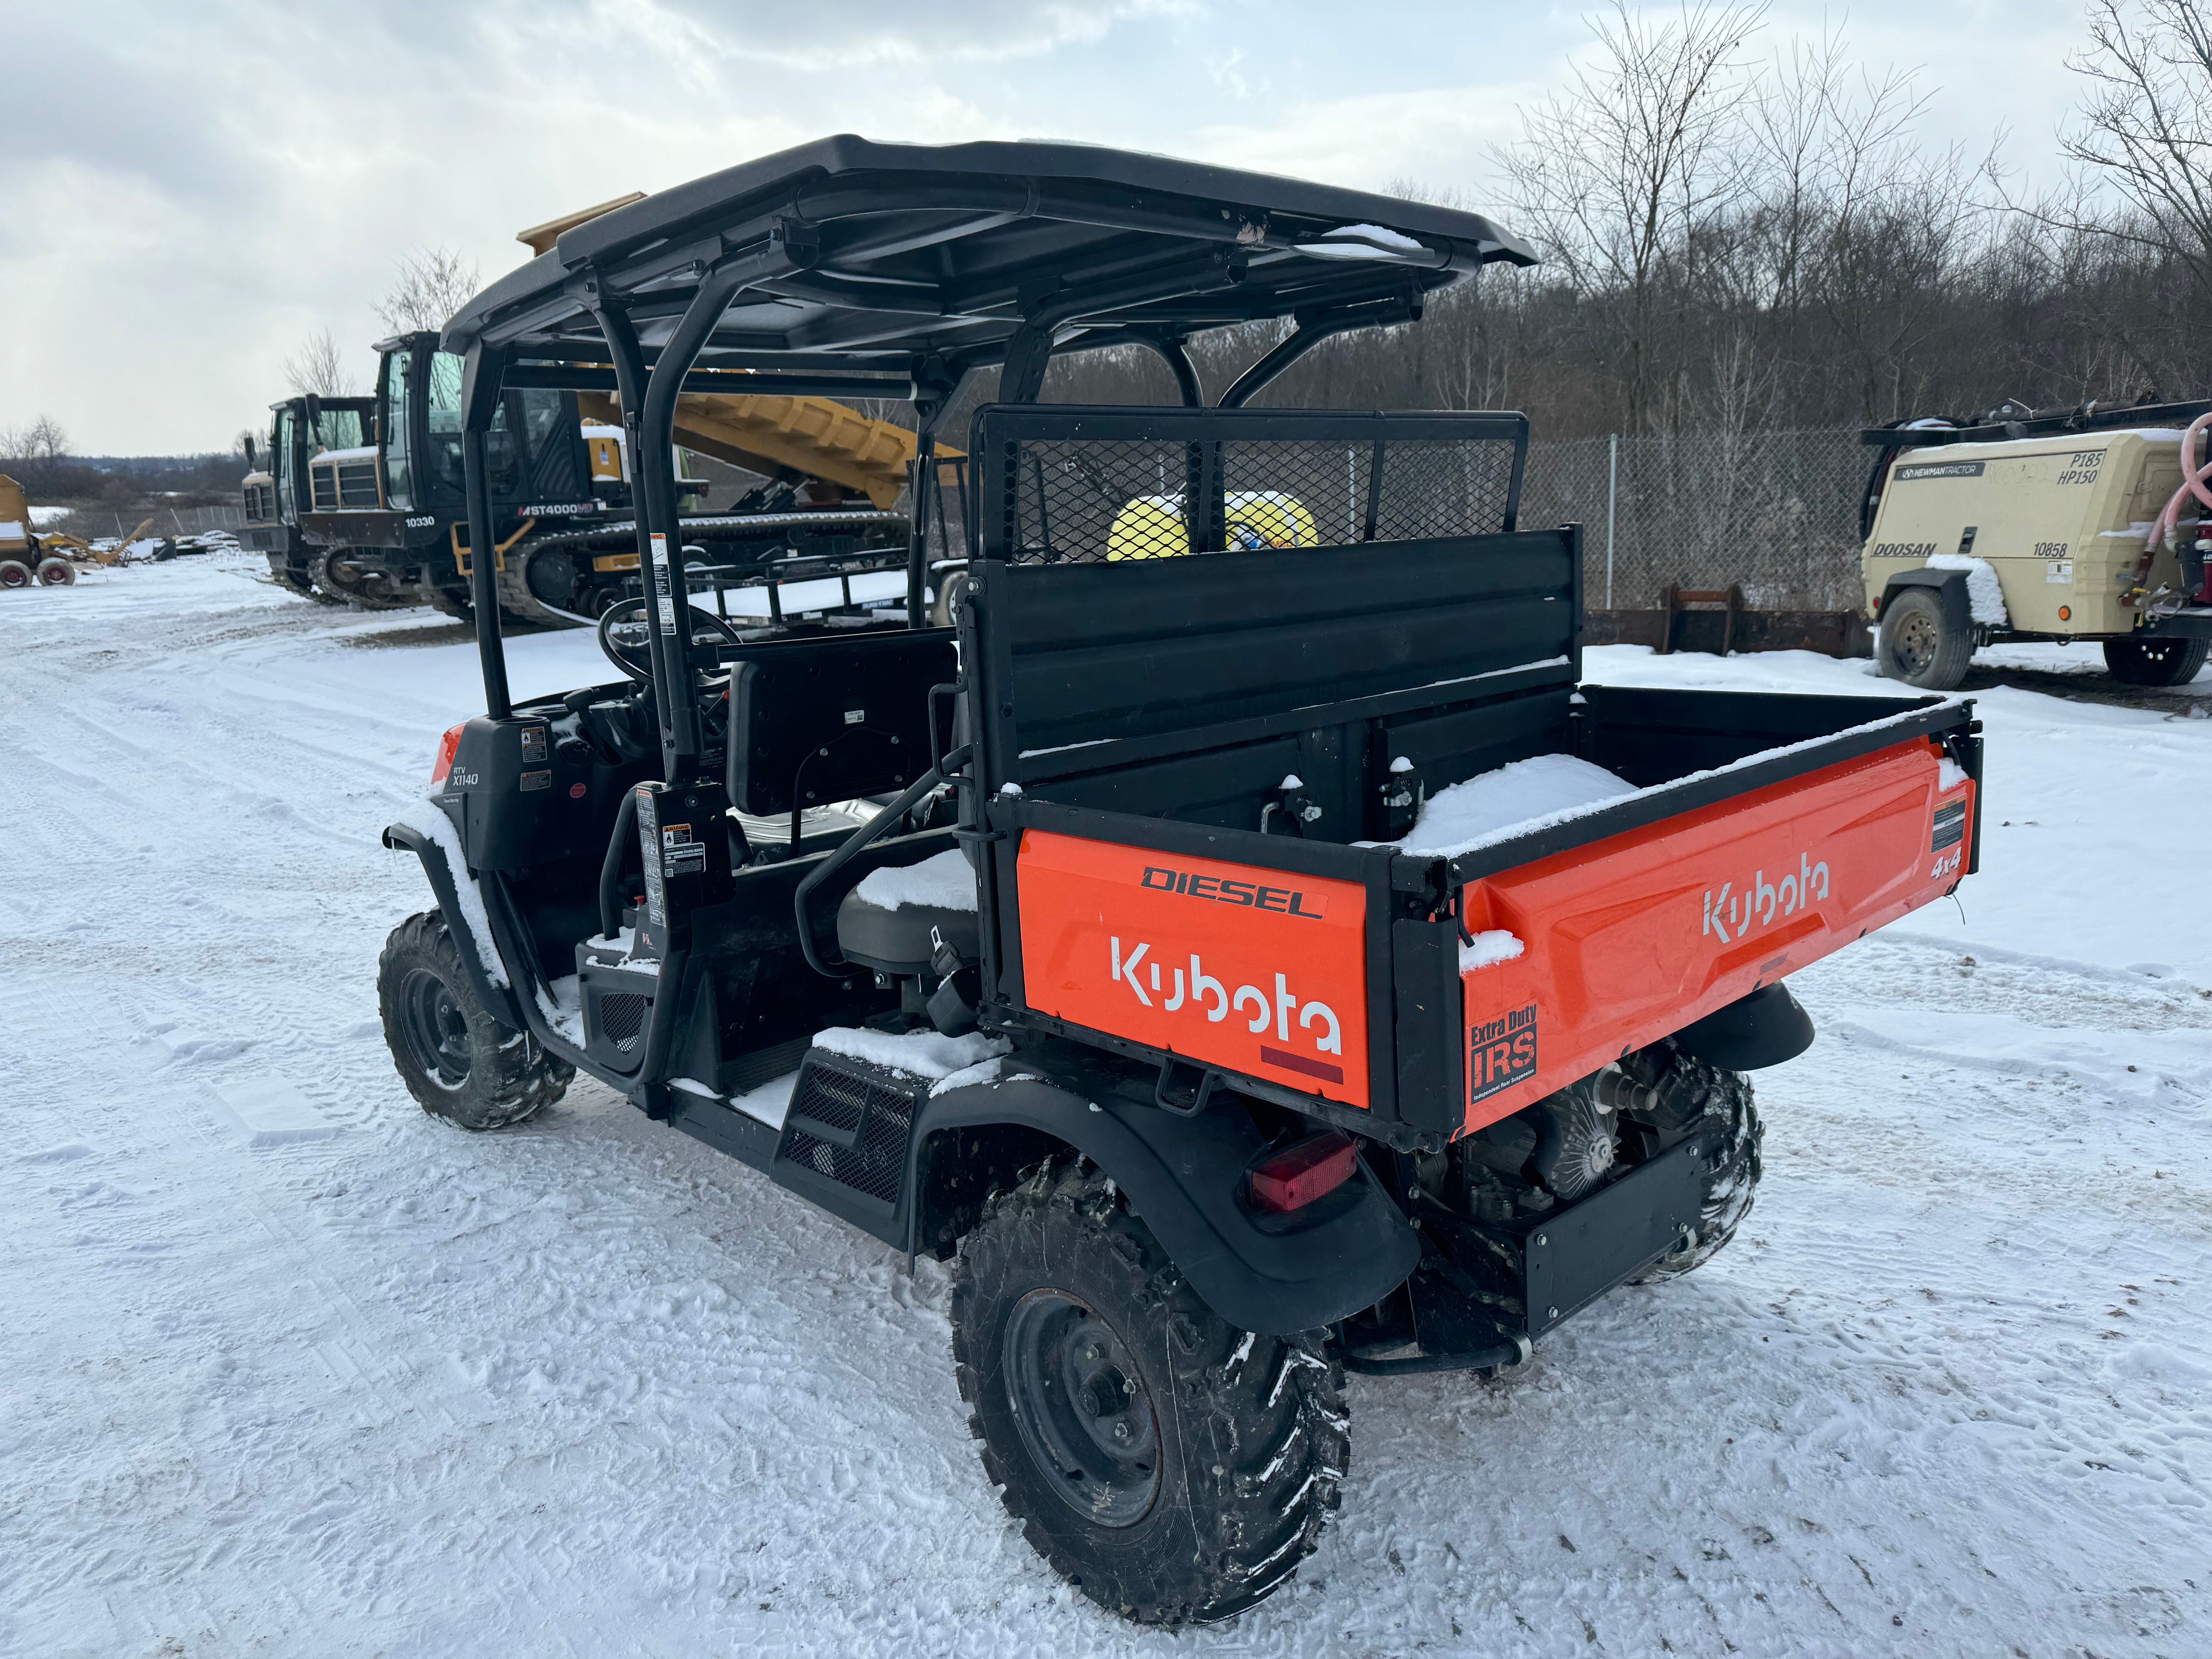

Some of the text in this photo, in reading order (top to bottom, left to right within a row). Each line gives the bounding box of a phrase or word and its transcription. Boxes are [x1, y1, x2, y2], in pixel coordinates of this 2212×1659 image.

[2070, 453, 2103, 468] P185
[2057, 470, 2098, 484] HP150
[405, 516, 434, 527] 10330
[1874, 543, 1937, 555] DOOSAN
[2034, 542, 2068, 557] 10858
[453, 774, 478, 786] X1140
[1931, 847, 1962, 879] 4x4
[1141, 867, 1323, 919] DIESEL
[1703, 852, 1829, 944] Kubota
[1111, 936, 1341, 1055] Kubota
[1471, 1004, 1537, 1047] Extra Duty
[1474, 1031, 1535, 1088] IRS
[1474, 1068, 1534, 1100] Independent Rear Suspension
